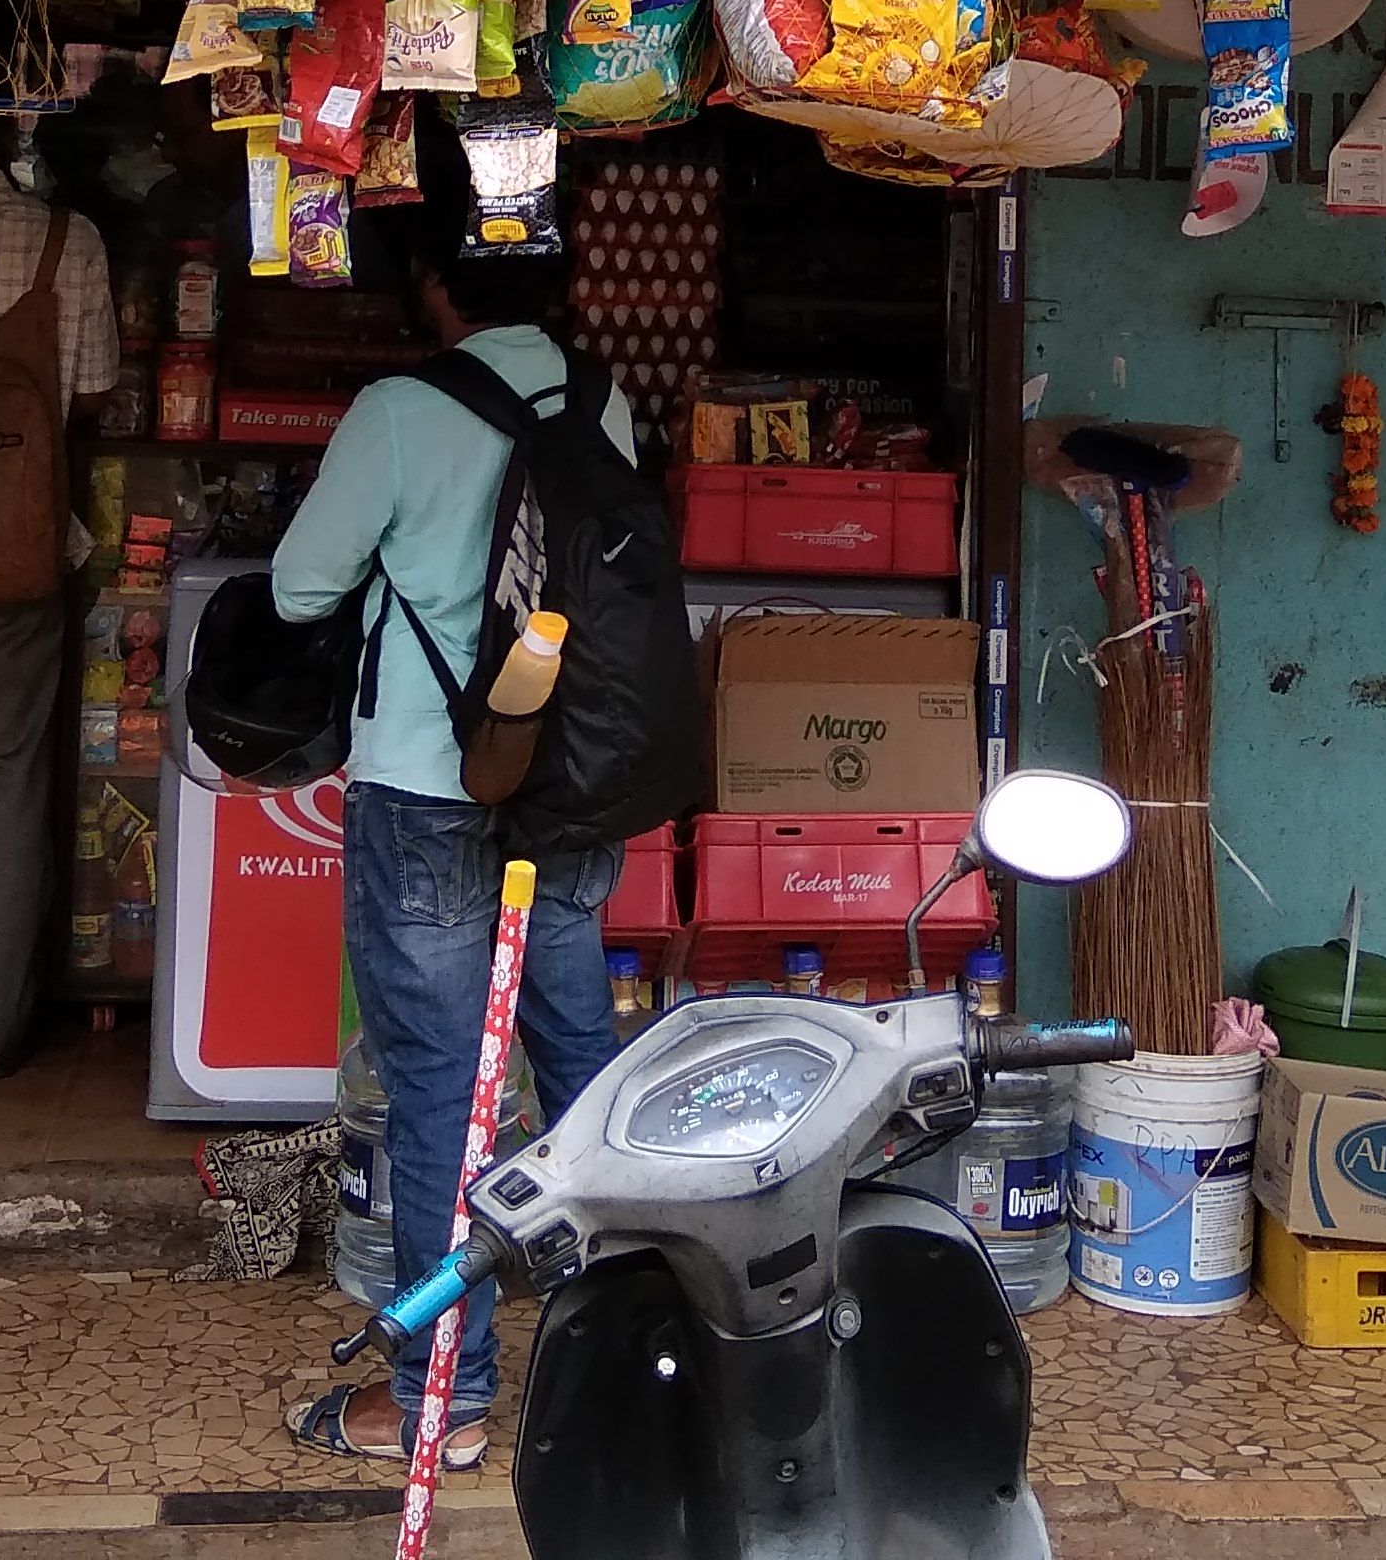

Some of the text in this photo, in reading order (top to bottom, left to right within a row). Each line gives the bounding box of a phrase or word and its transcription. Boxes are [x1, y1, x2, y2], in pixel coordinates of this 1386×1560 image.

[1212, 101, 1272, 127] CHOCOS
[230, 407, 341, 428] Take me ho
[993, 579, 1004, 625] Crompton
[992, 633, 1004, 679] Crompton
[991, 688, 1004, 734] Crompton
[803, 713, 887, 744] Margo
[781, 866, 892, 893] Kedar Milk
[832, 893, 869, 903] MAR-17
[970, 1165, 993, 1183] 300%
[1008, 1179, 1060, 1220] Oxyrich
